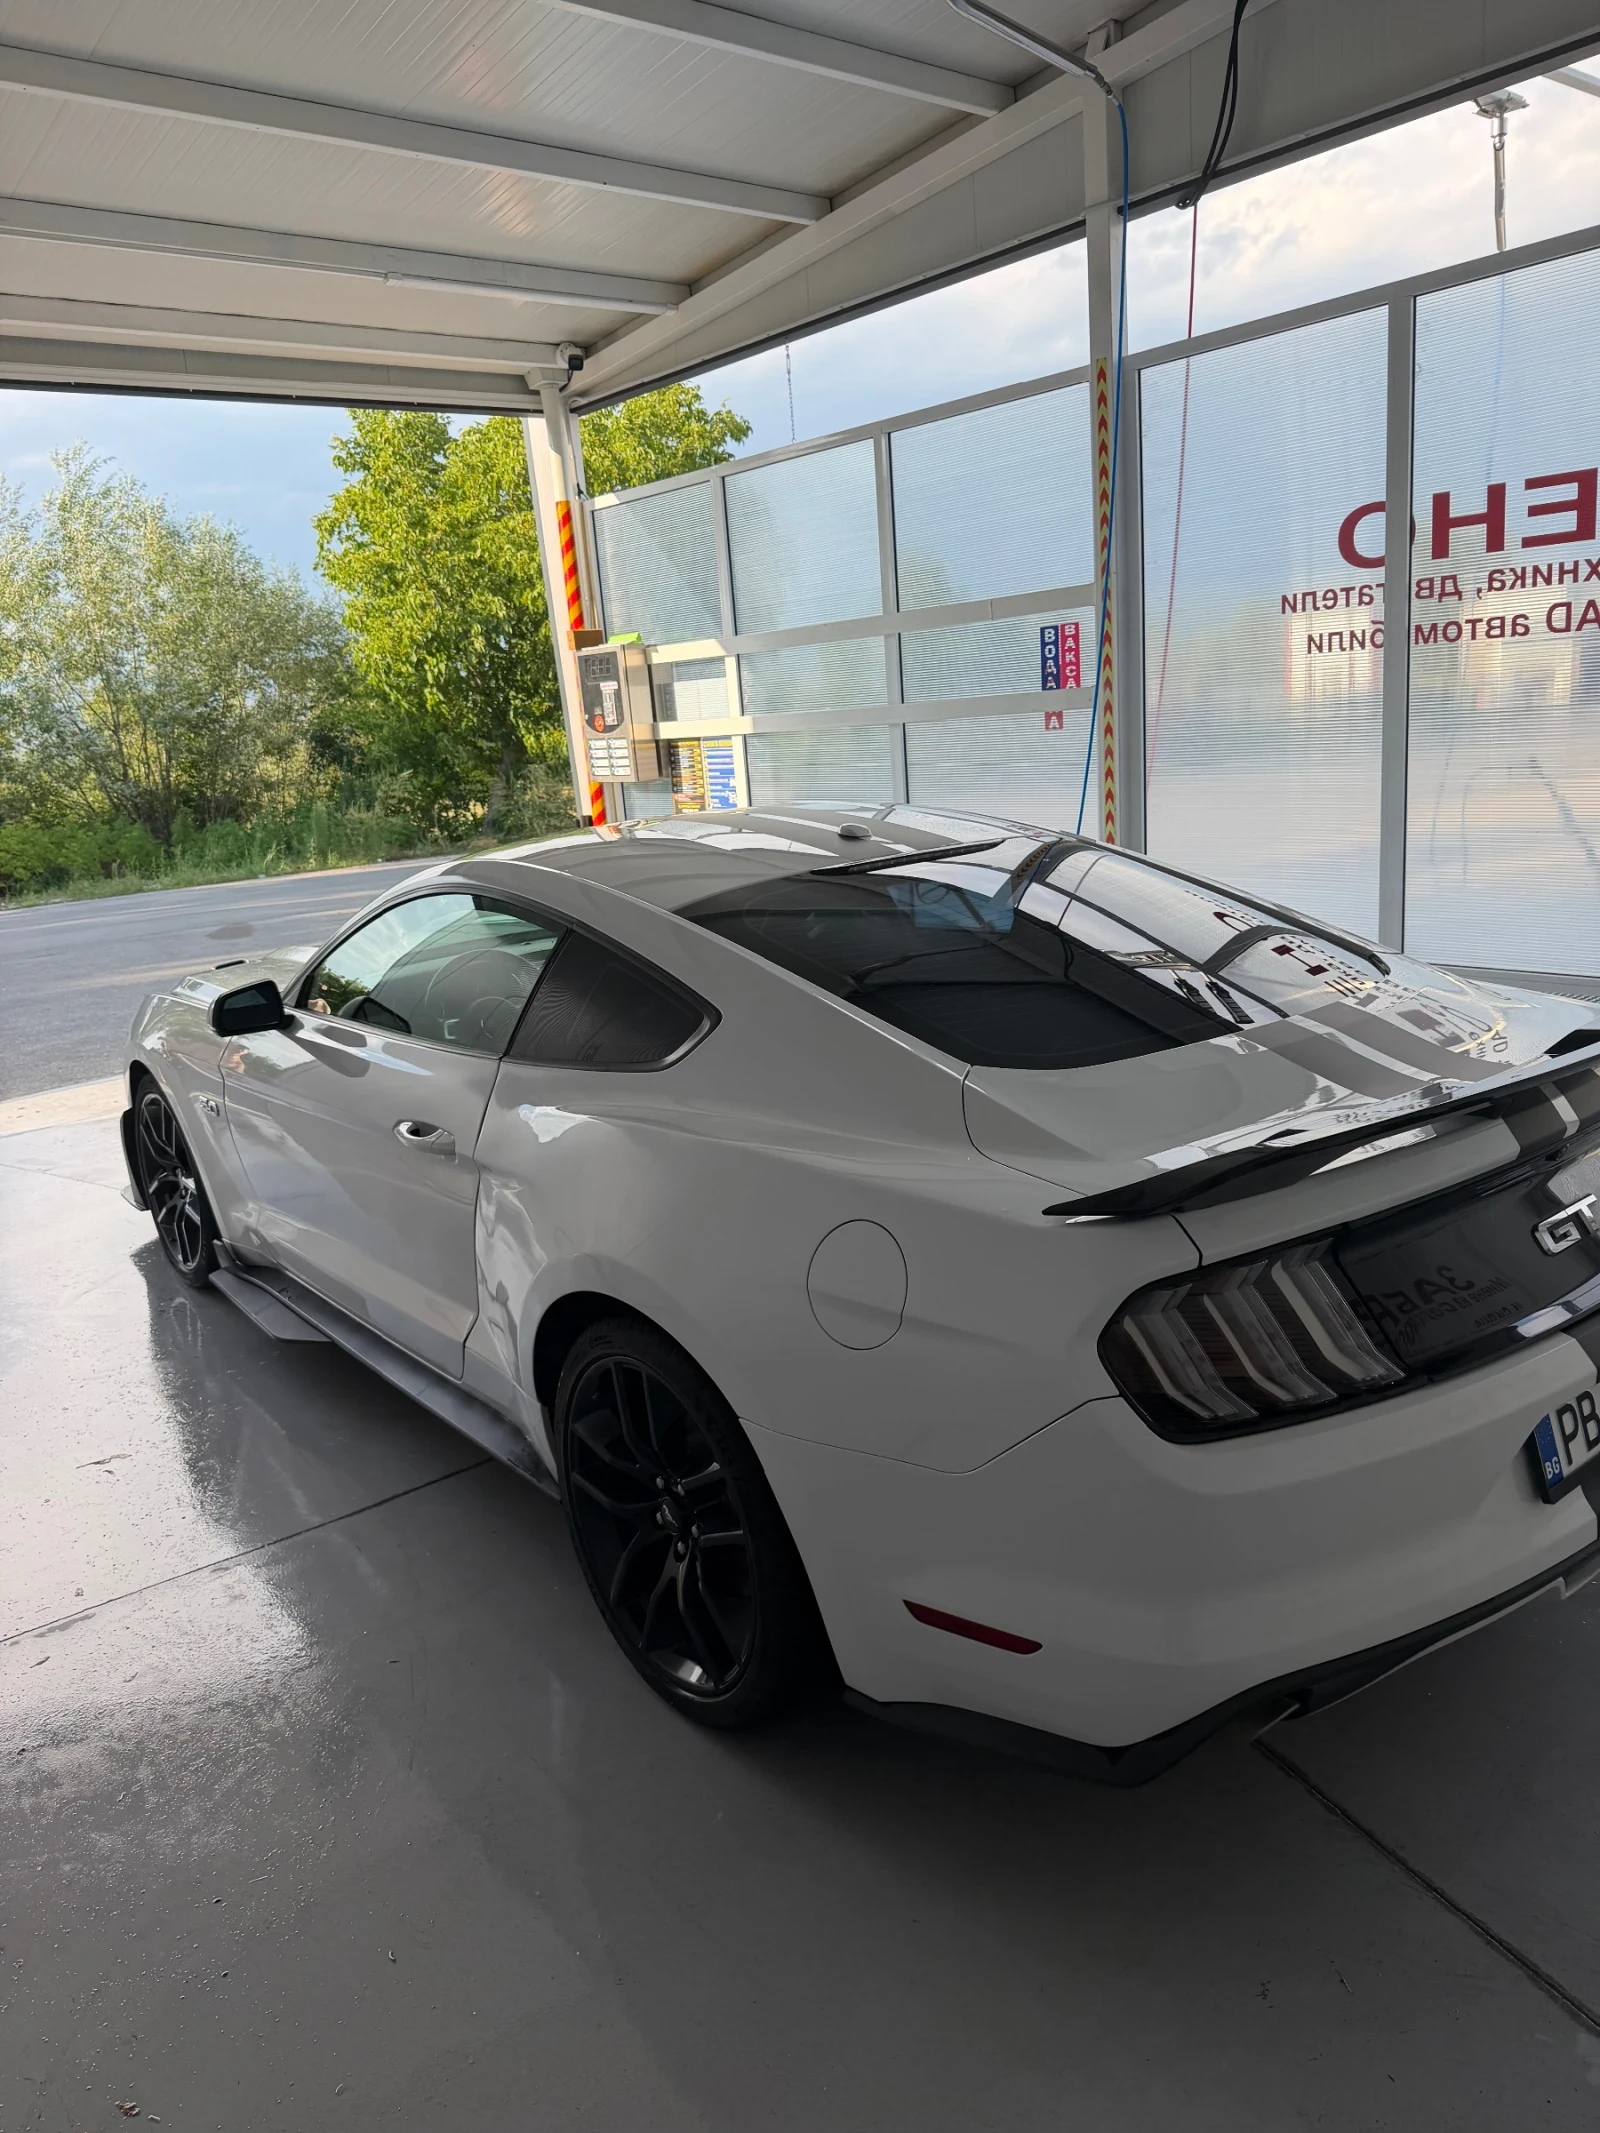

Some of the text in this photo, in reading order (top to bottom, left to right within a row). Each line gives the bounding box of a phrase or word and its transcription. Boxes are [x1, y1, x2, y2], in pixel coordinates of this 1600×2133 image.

[1049, 711, 1060, 729] А
[1534, 1193, 1600, 1255] GT
[1544, 1456, 1560, 1480] BG
